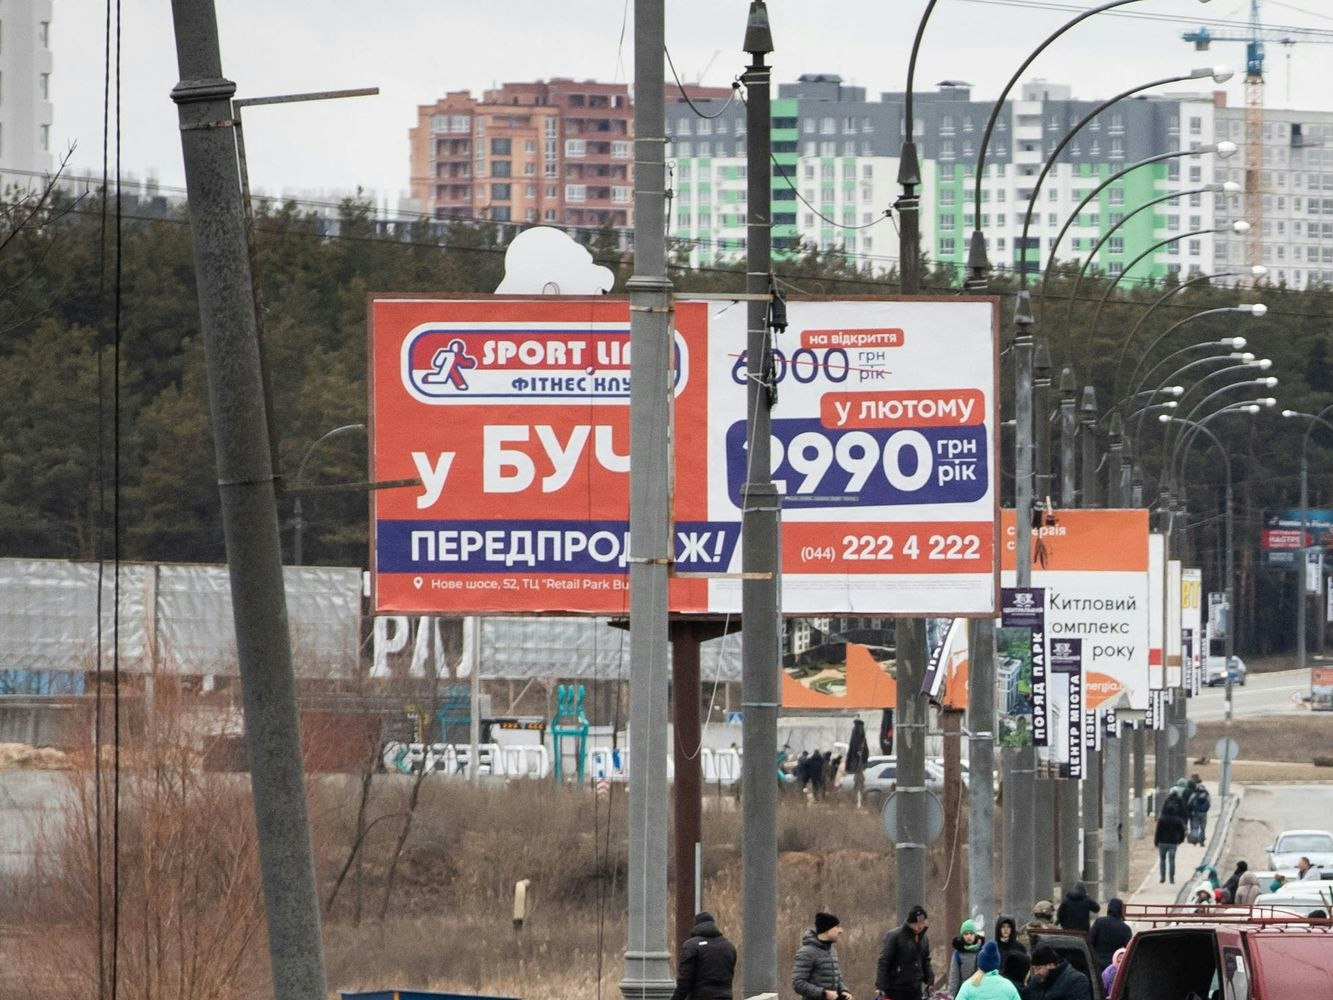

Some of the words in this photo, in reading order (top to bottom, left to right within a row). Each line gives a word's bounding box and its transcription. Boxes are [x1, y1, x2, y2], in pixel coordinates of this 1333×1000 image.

[809, 335, 828, 345] на
[831, 332, 897, 346] відкриття
[482, 340, 586, 365] SPORT
[859, 352, 885, 362] грн
[511, 377, 586, 392] ФІТНЕС
[859, 366, 885, 383] рік
[937, 438, 976, 458] грн
[938, 460, 976, 486] рік
[1007, 525, 1067, 539] сергія
[411, 530, 726, 567] ПЕРЕДПРОЖ!
[800, 546, 836, 563] (044)
[842, 535, 894, 560] 222
[902, 535, 920, 560] 4
[928, 535, 981, 560] 222
[431, 579, 456, 590] Нове
[460, 580, 500, 592] шосе,
[503, 579, 520, 592] 52,
[522, 578, 540, 592] ТЦ
[542, 578, 579, 590] "Retail
[583, 579, 609, 591] Park
[1050, 621, 1130, 634] омплекс
[1032, 632, 1043, 677] ПАРК
[1092, 644, 1135, 662] року
[1070, 674, 1080, 723] МІСТА
[1033, 682, 1046, 739] ПОРЯД
[1070, 728, 1080, 776] ЦЕНТР
